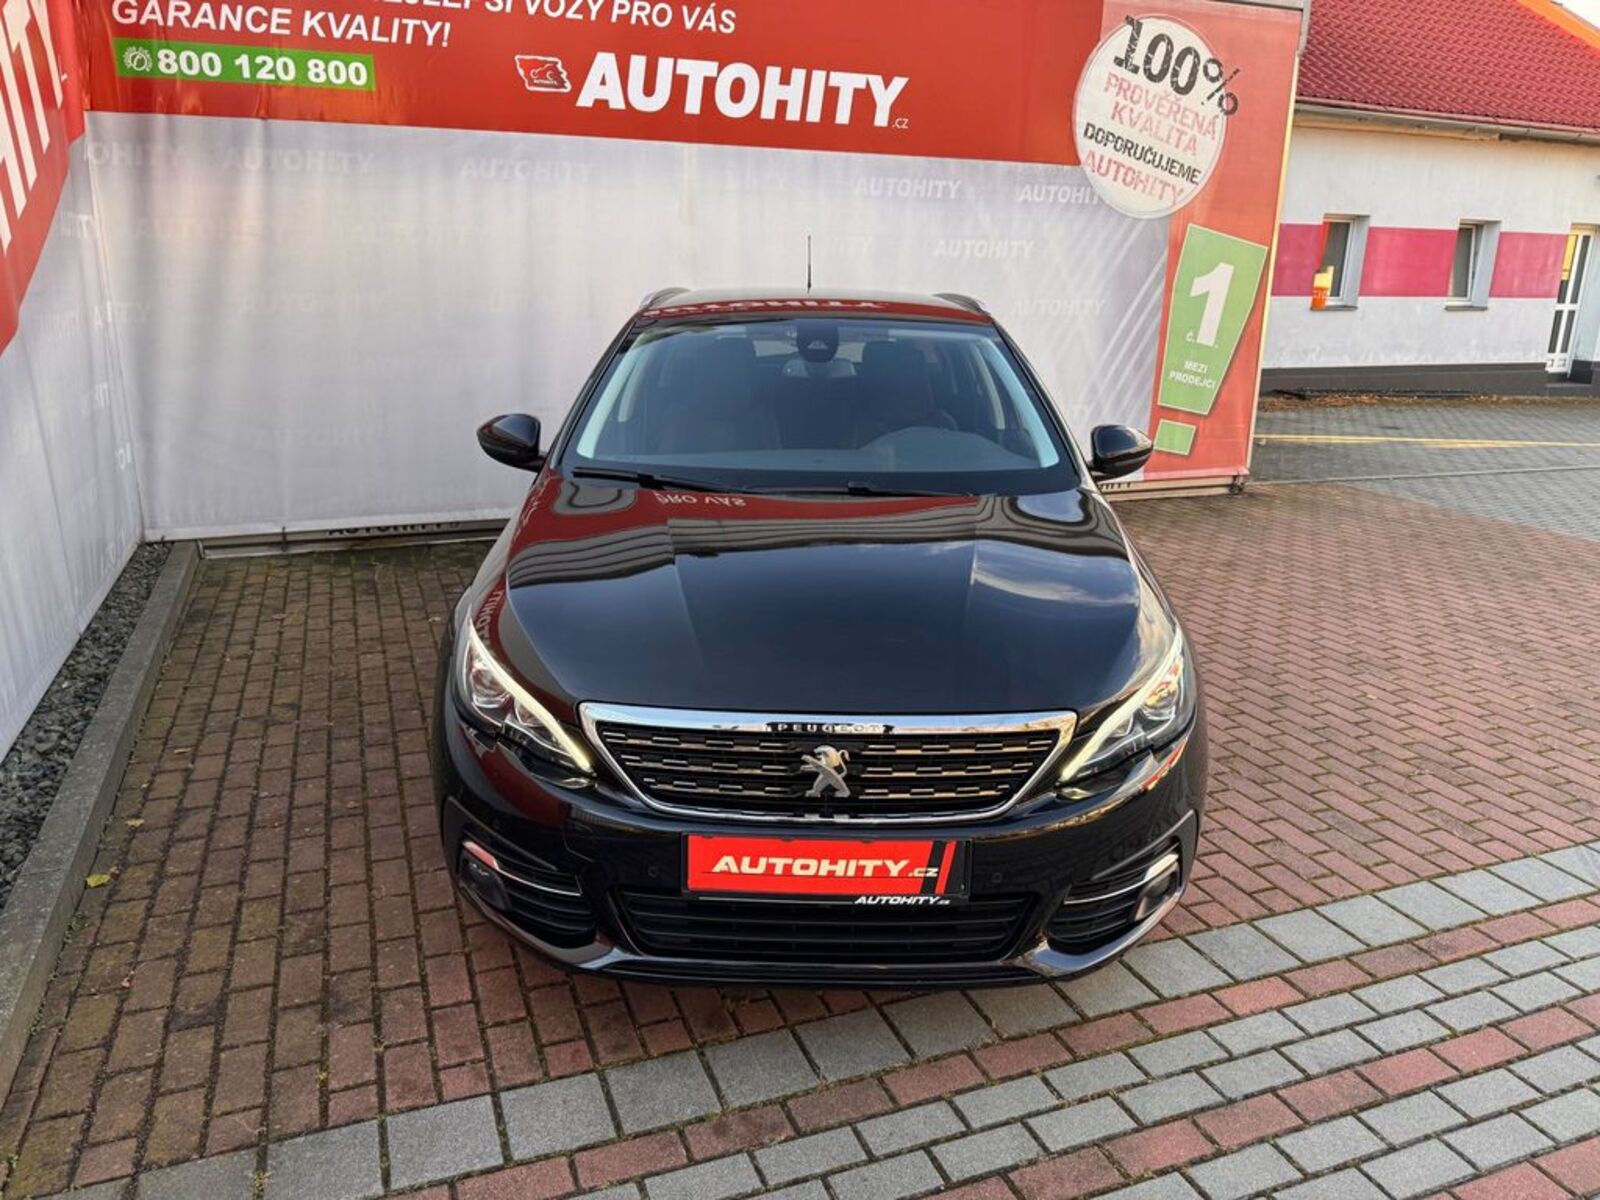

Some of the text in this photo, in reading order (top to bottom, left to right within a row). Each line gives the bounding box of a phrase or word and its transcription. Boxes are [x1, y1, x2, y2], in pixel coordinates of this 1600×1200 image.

[111, 0, 451, 48] GARANCE KVALITY!
[525, 0, 601, 21] VOZY
[611, 0, 673, 28] PRO
[682, 3, 737, 34] VÁS
[156, 48, 368, 86] 800 120 800
[1113, 15, 1240, 116] 100%
[1104, 72, 1220, 141] PROVĚŘENÁ
[1110, 101, 1199, 156] KVALITA
[1083, 122, 1203, 186] DOPORUČUJEME
[853, 177, 962, 200] AUTOHITY
[1085, 150, 1184, 208] AUTOHITY
[932, 239, 1034, 260] AUTOHITY
[1169, 371, 1216, 390] PRODEJCI
[1184, 360, 1209, 374] MEZI
[777, 723, 881, 734] PEUGEOT
